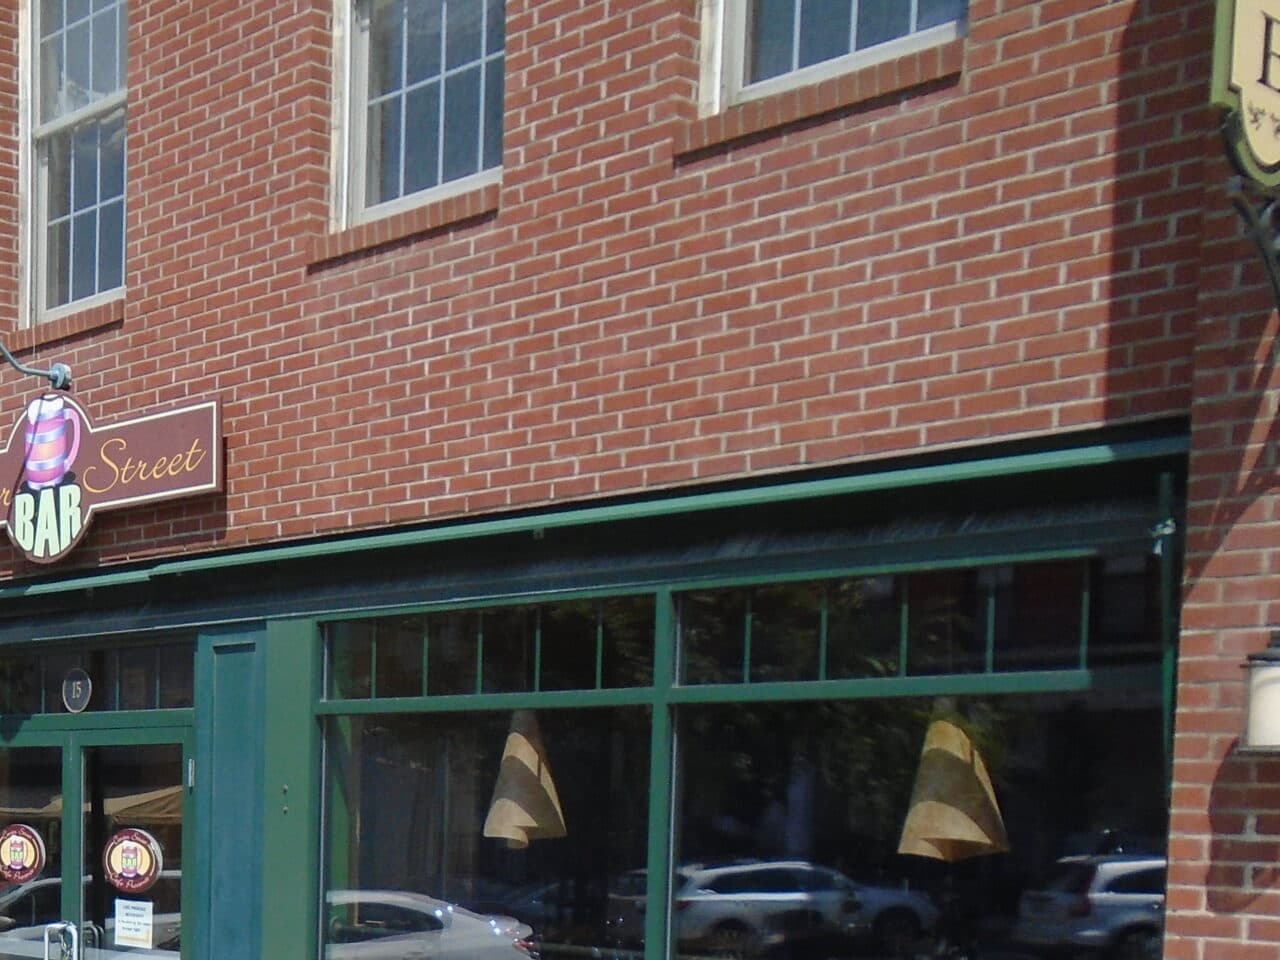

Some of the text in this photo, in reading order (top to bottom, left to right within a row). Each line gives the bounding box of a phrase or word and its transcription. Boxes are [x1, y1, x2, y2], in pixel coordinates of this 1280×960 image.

[83, 438, 207, 494] Street
[14, 484, 82, 558] BAR
[72, 680, 82, 699] 15
